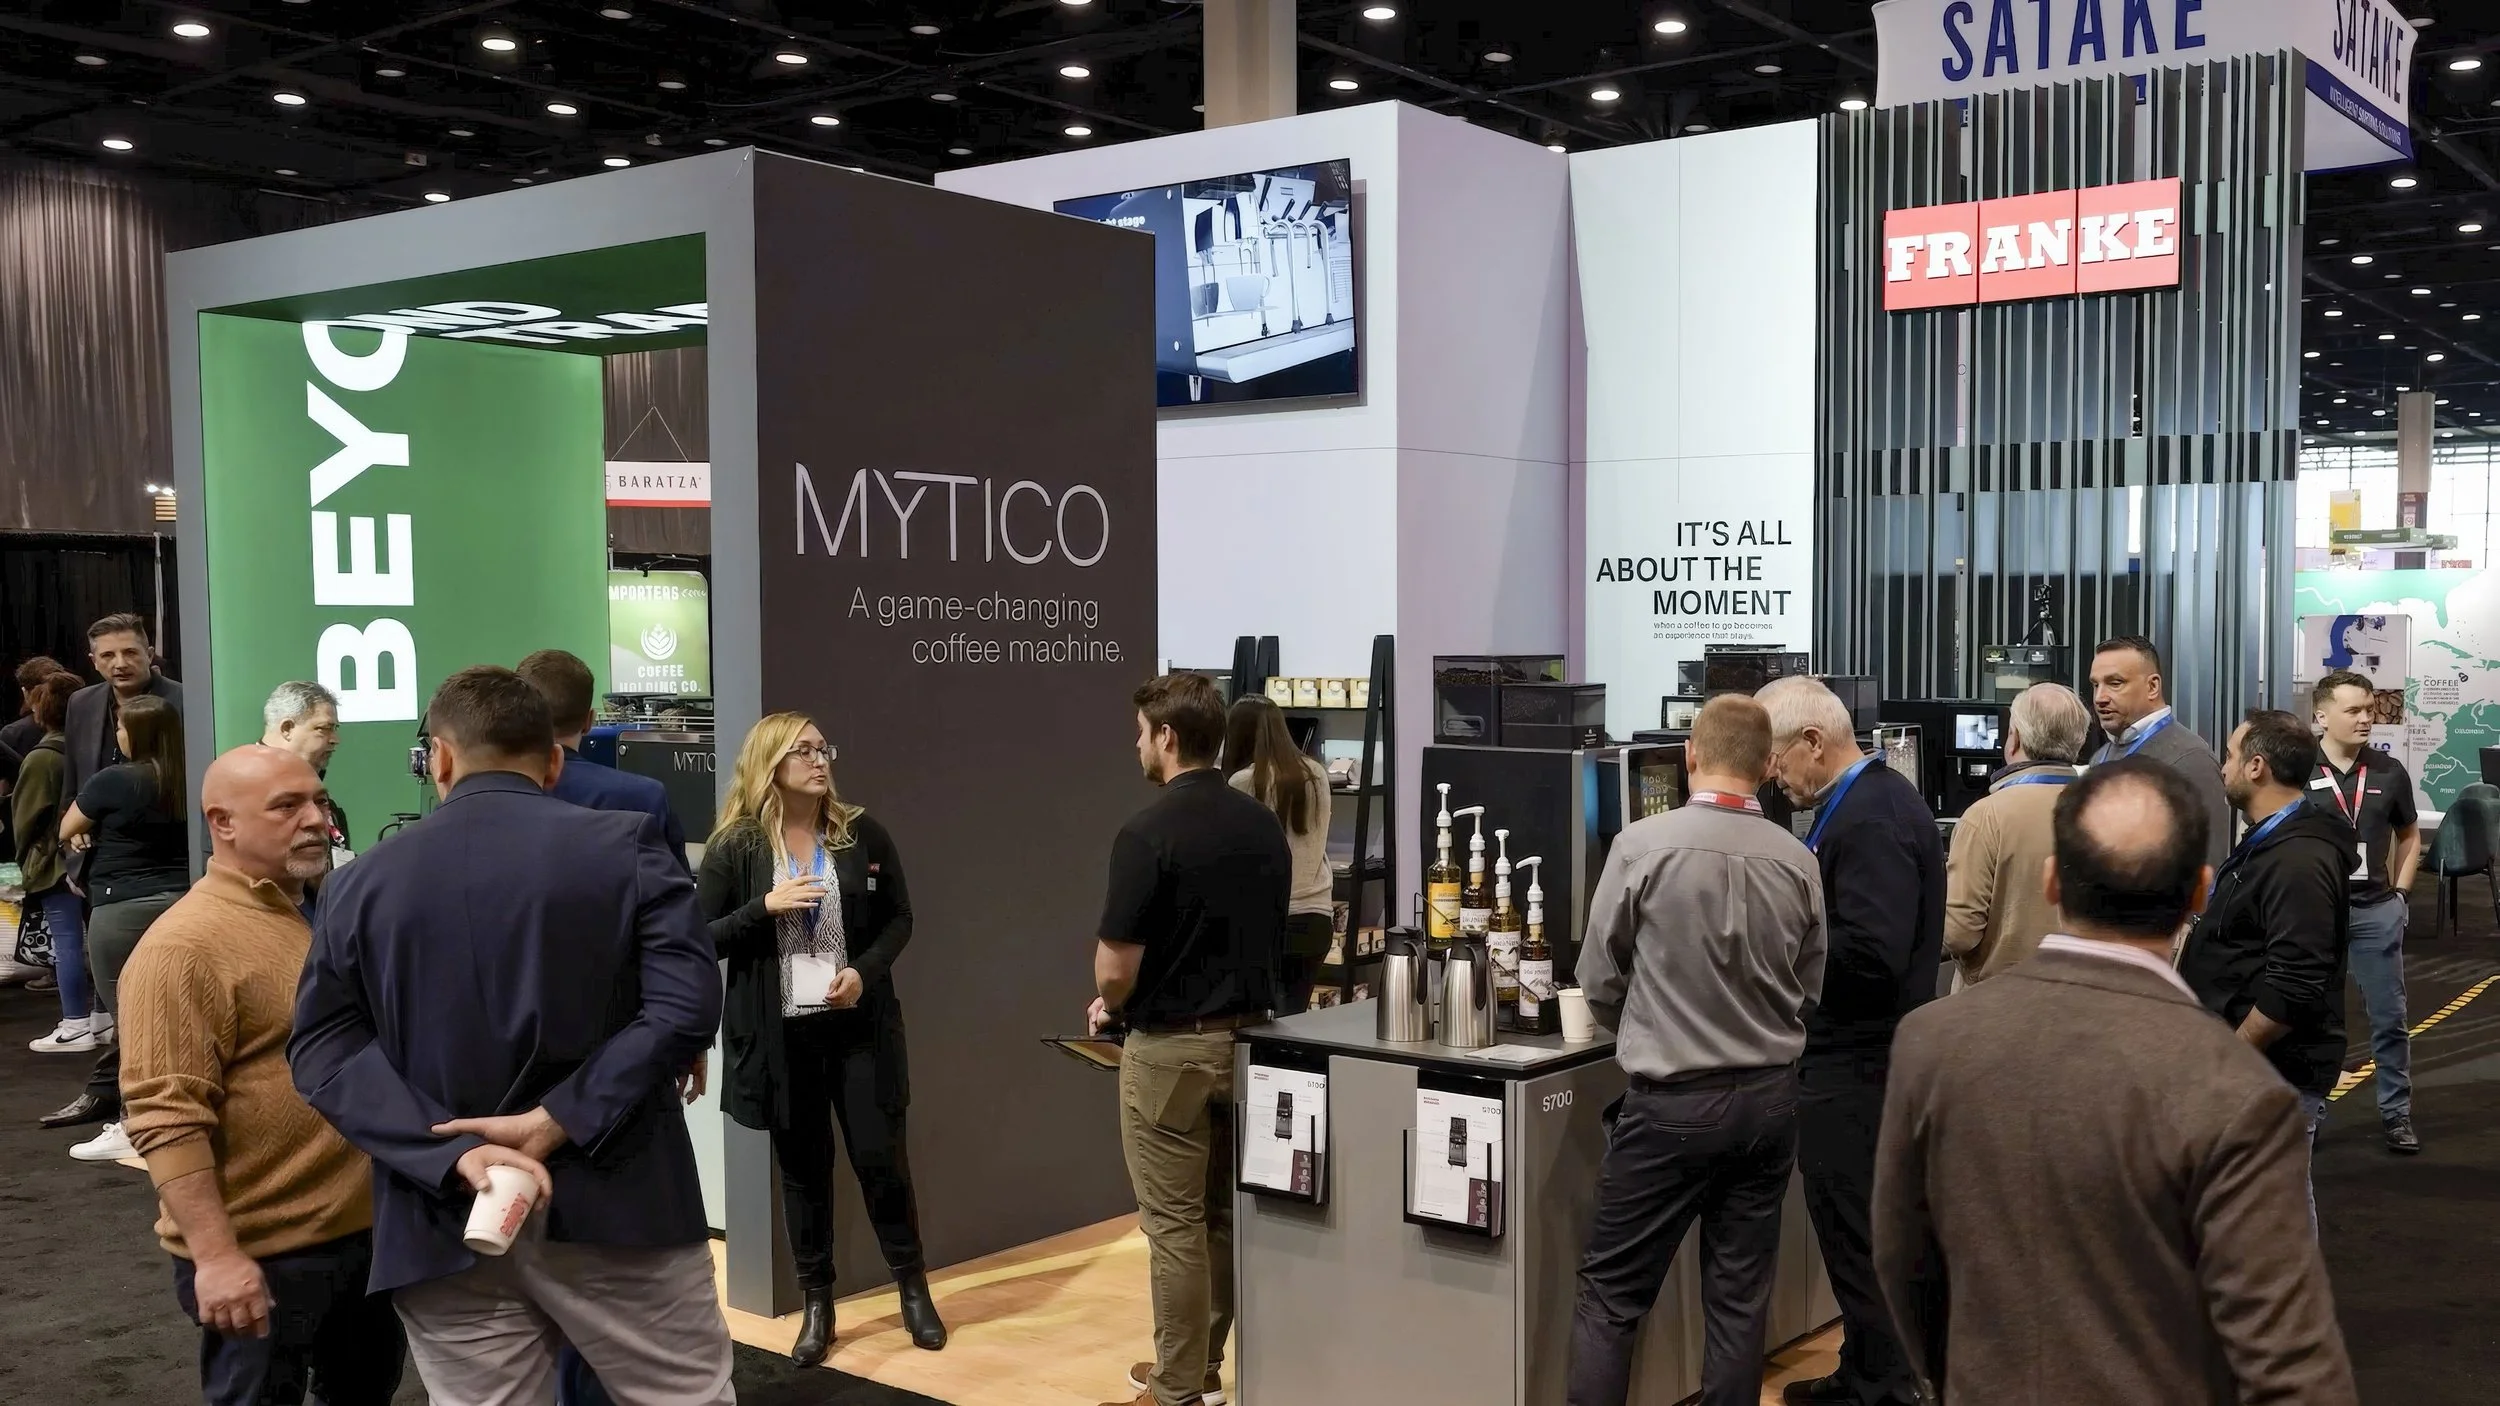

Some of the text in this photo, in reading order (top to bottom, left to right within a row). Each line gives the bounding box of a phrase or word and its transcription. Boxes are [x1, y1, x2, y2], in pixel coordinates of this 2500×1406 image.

[1942, 0, 2206, 82] SATAKE
[2332, 0, 2402, 104] SATAKE
[1887, 207, 2176, 283] FRANKE
[439, 302, 708, 344] TRA
[618, 475, 699, 489] BARATZA
[795, 461, 1110, 567] MYTICO
[1677, 520, 1793, 547] IT'S ALL
[1596, 556, 1763, 582] ABOUT THE
[608, 584, 679, 601] MPORTERS
[1653, 590, 1792, 616] MOMENT
[848, 586, 1099, 630] A game-changing
[912, 632, 1125, 664] coffee machine.
[637, 664, 685, 678] COFFEE
[681, 679, 702, 693] CO.
[1542, 1089, 1574, 1112] S700
